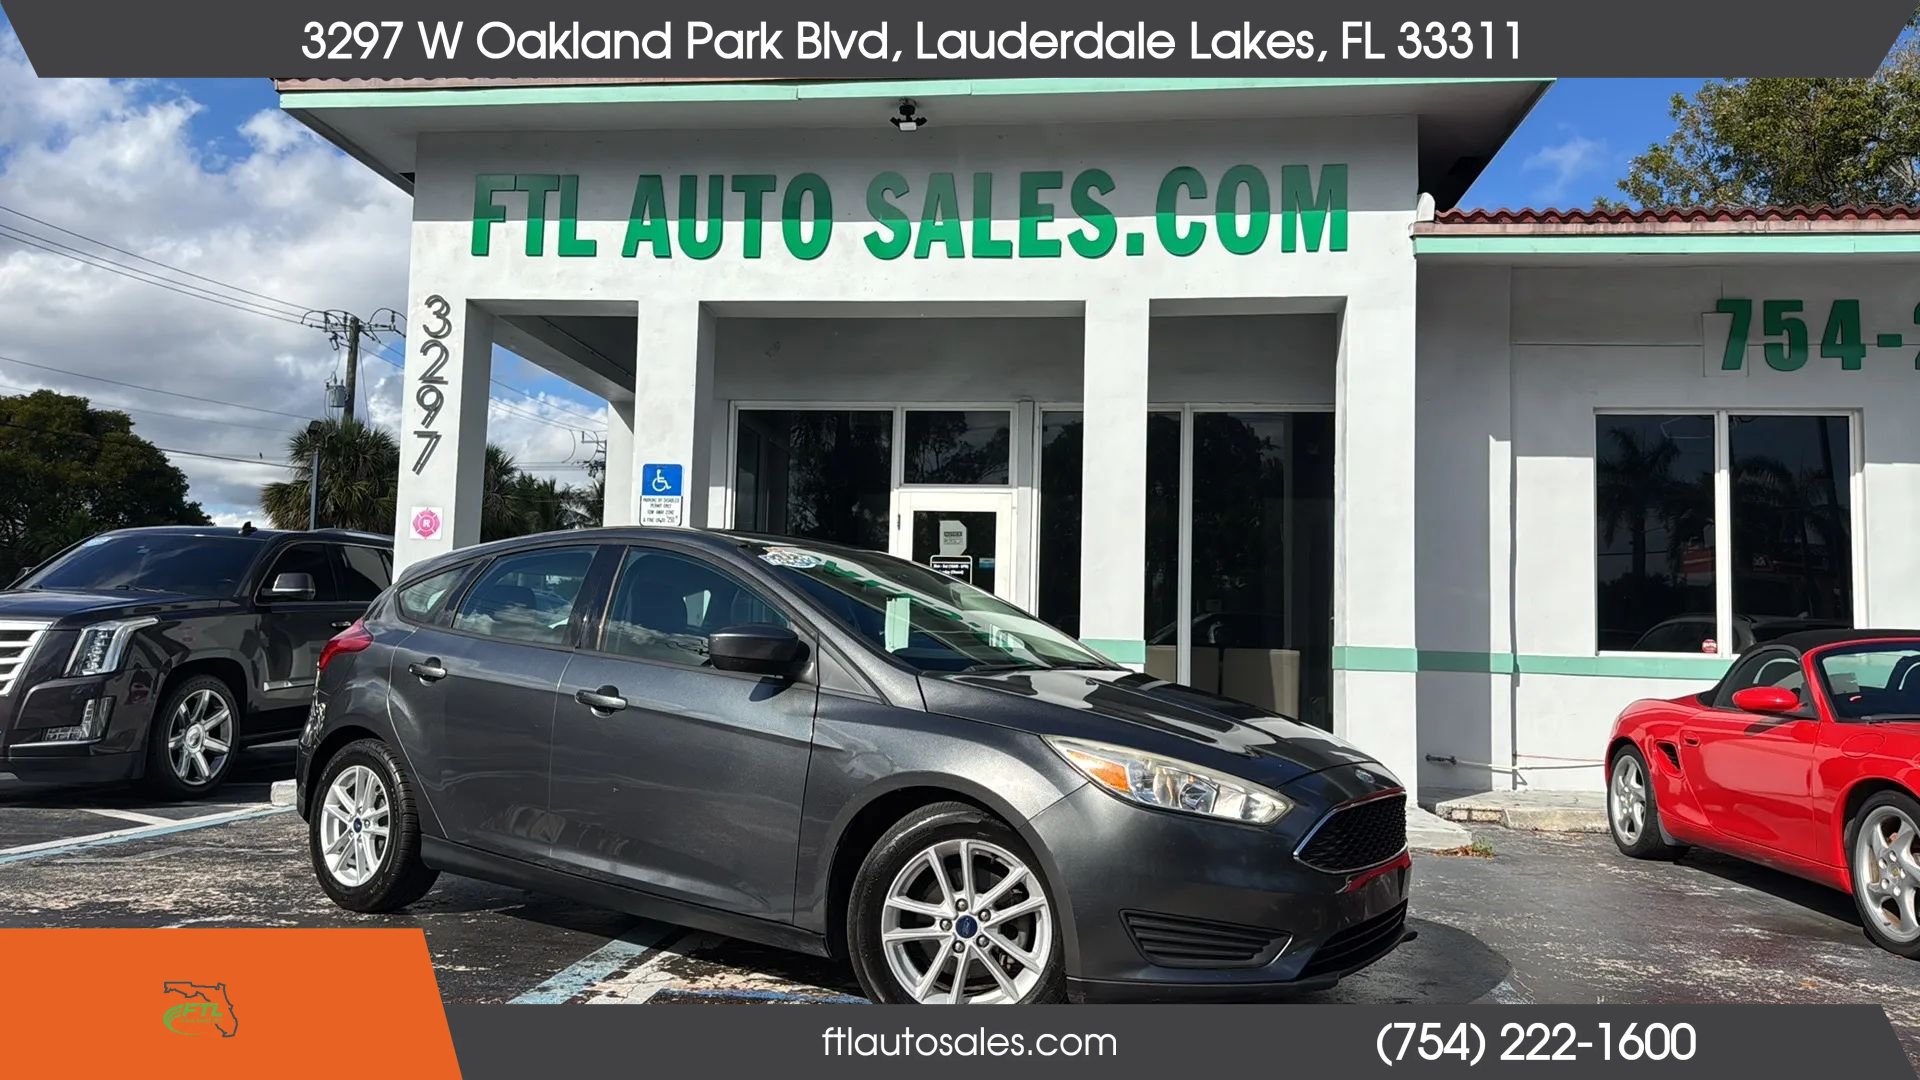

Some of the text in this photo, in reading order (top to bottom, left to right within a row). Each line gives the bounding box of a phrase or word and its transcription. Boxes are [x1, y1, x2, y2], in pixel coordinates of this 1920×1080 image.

[470, 163, 1349, 260] FTL AUTO SALES.COM
[1716, 299, 1920, 371] 754-
[412, 294, 452, 476] 3297
